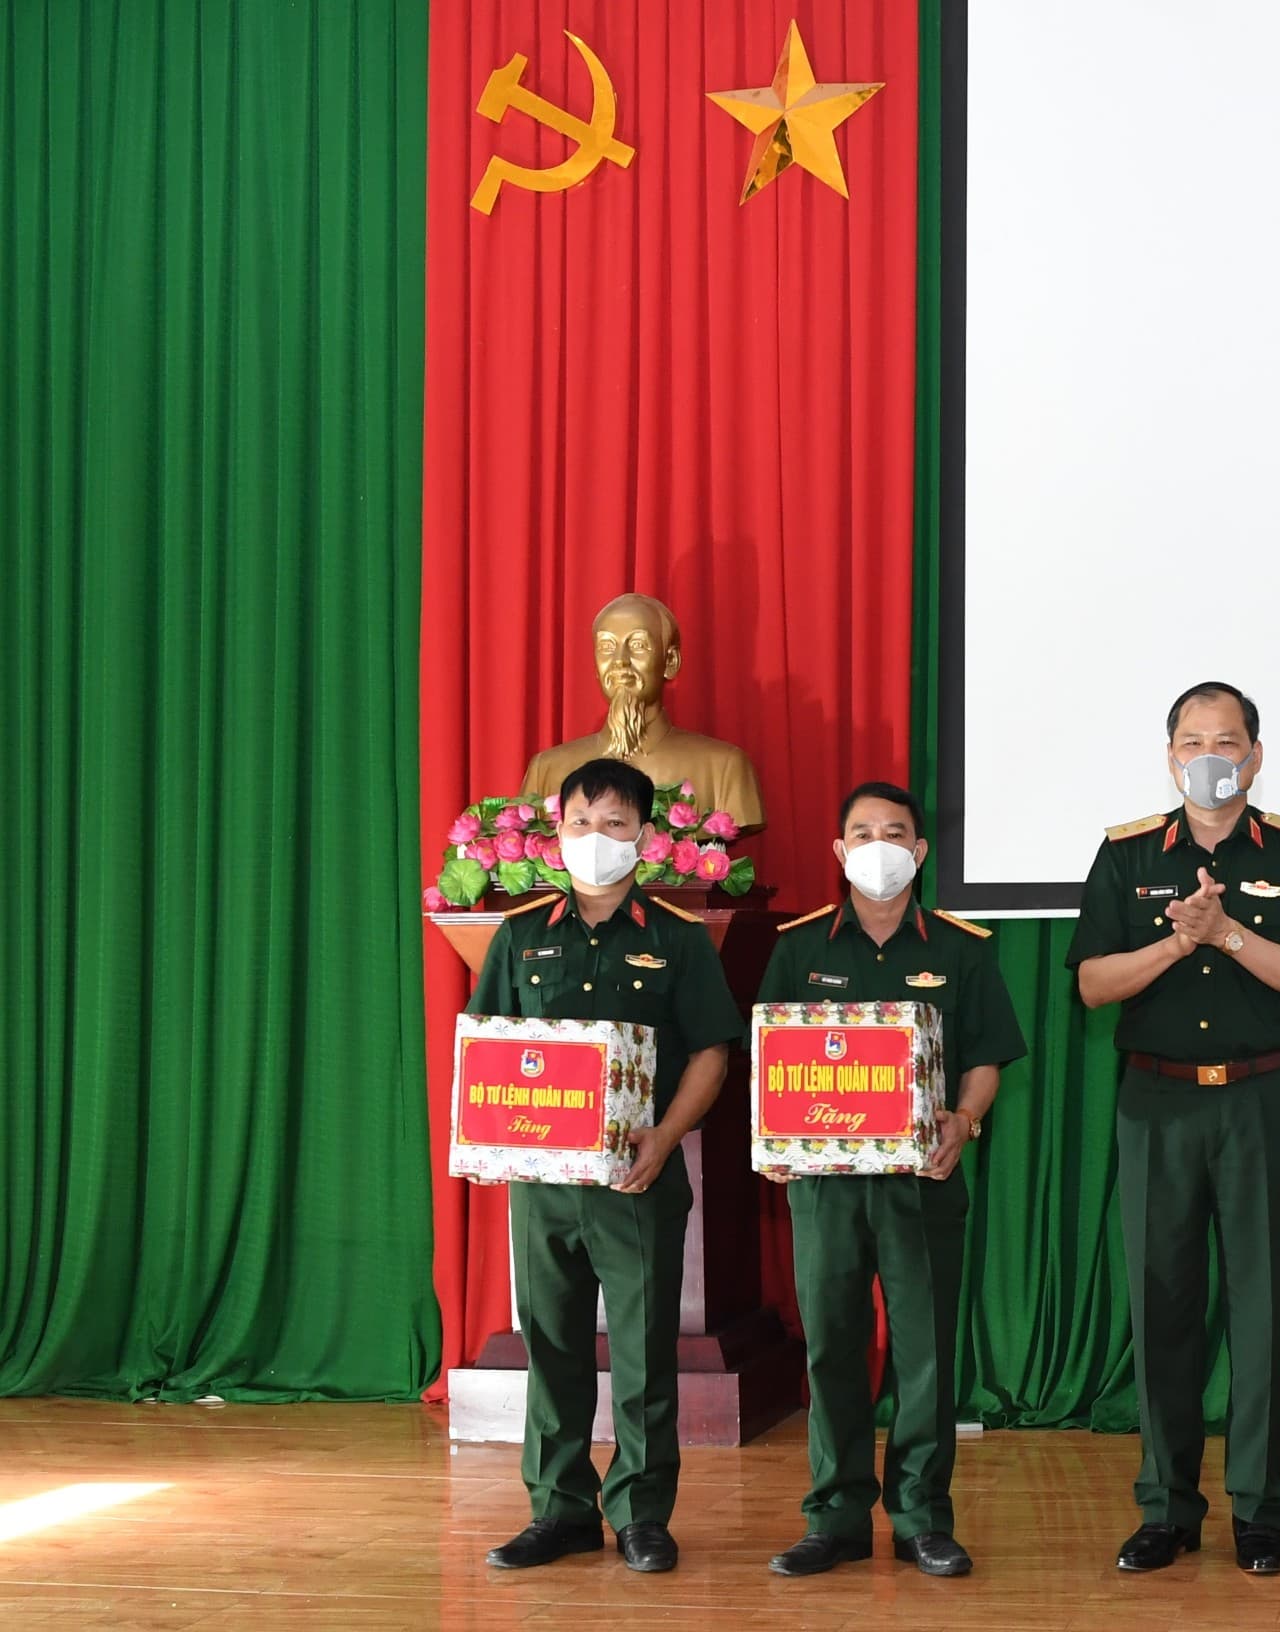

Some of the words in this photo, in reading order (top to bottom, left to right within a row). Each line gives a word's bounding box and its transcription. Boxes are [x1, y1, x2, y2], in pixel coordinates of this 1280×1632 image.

[768, 1060, 784, 1098] BỘ
[787, 1063, 803, 1092] TƯ
[804, 1060, 834, 1098] LỆNH
[836, 1060, 869, 1095] QUÂN
[871, 1066, 896, 1092] KHU
[898, 1067, 905, 1092] 1
[469, 1082, 484, 1108] BỘ
[486, 1084, 502, 1104] TƯ
[502, 1083, 530, 1109] LỆNH
[531, 1085, 562, 1109] QUÂN
[563, 1089, 586, 1109] KHU
[588, 1091, 594, 1109] 1
[507, 1115, 552, 1140] Tặng
[804, 1103, 867, 1132] Tặng
